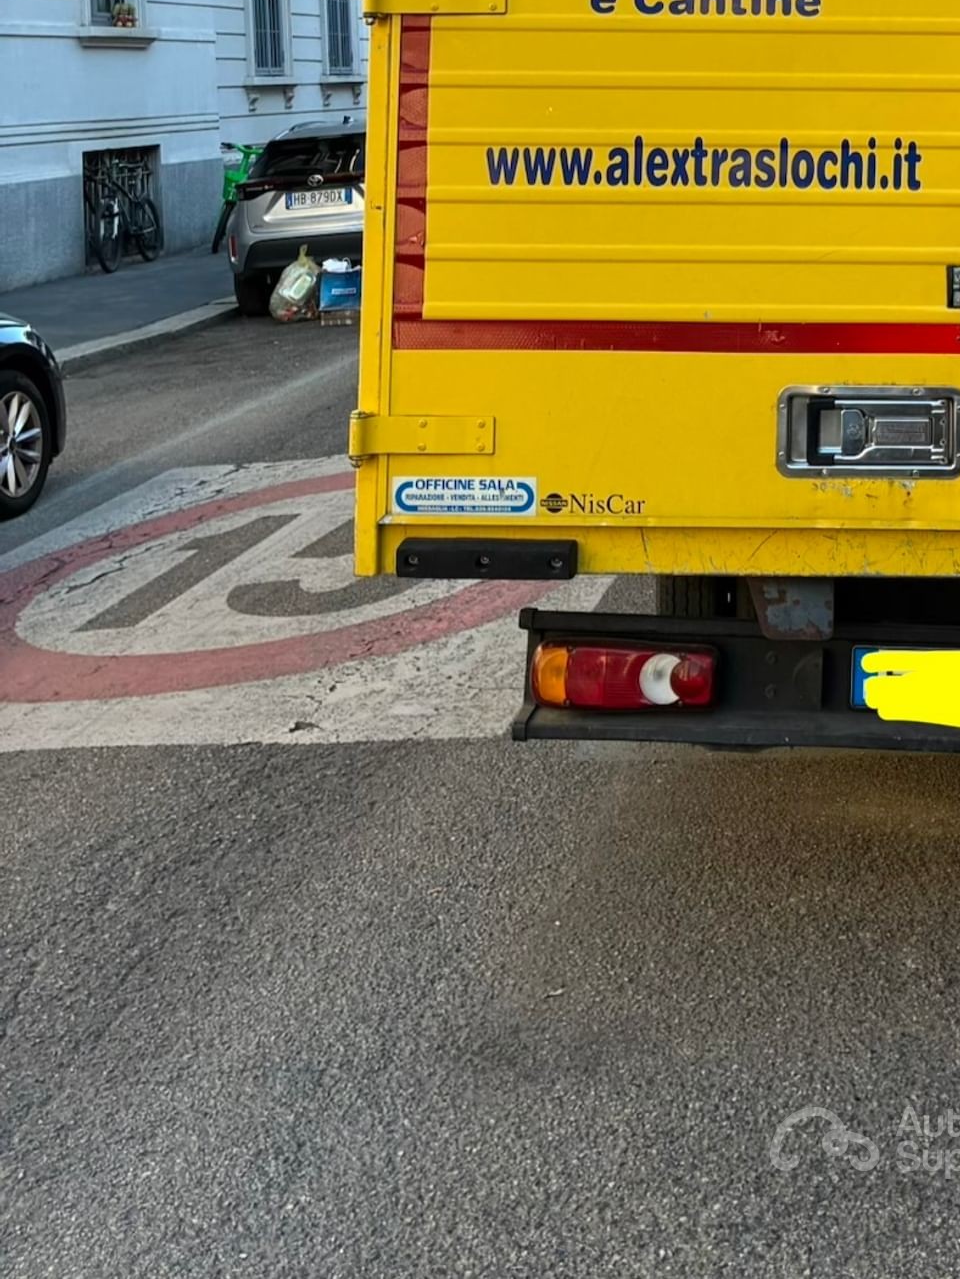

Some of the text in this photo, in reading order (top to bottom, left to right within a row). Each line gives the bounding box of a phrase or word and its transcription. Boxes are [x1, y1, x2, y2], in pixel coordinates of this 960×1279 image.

[487, 137, 922, 191] www.alextraslochi.it
[415, 478, 516, 492] OFFICINE SALA
[569, 493, 646, 515] NisCar
